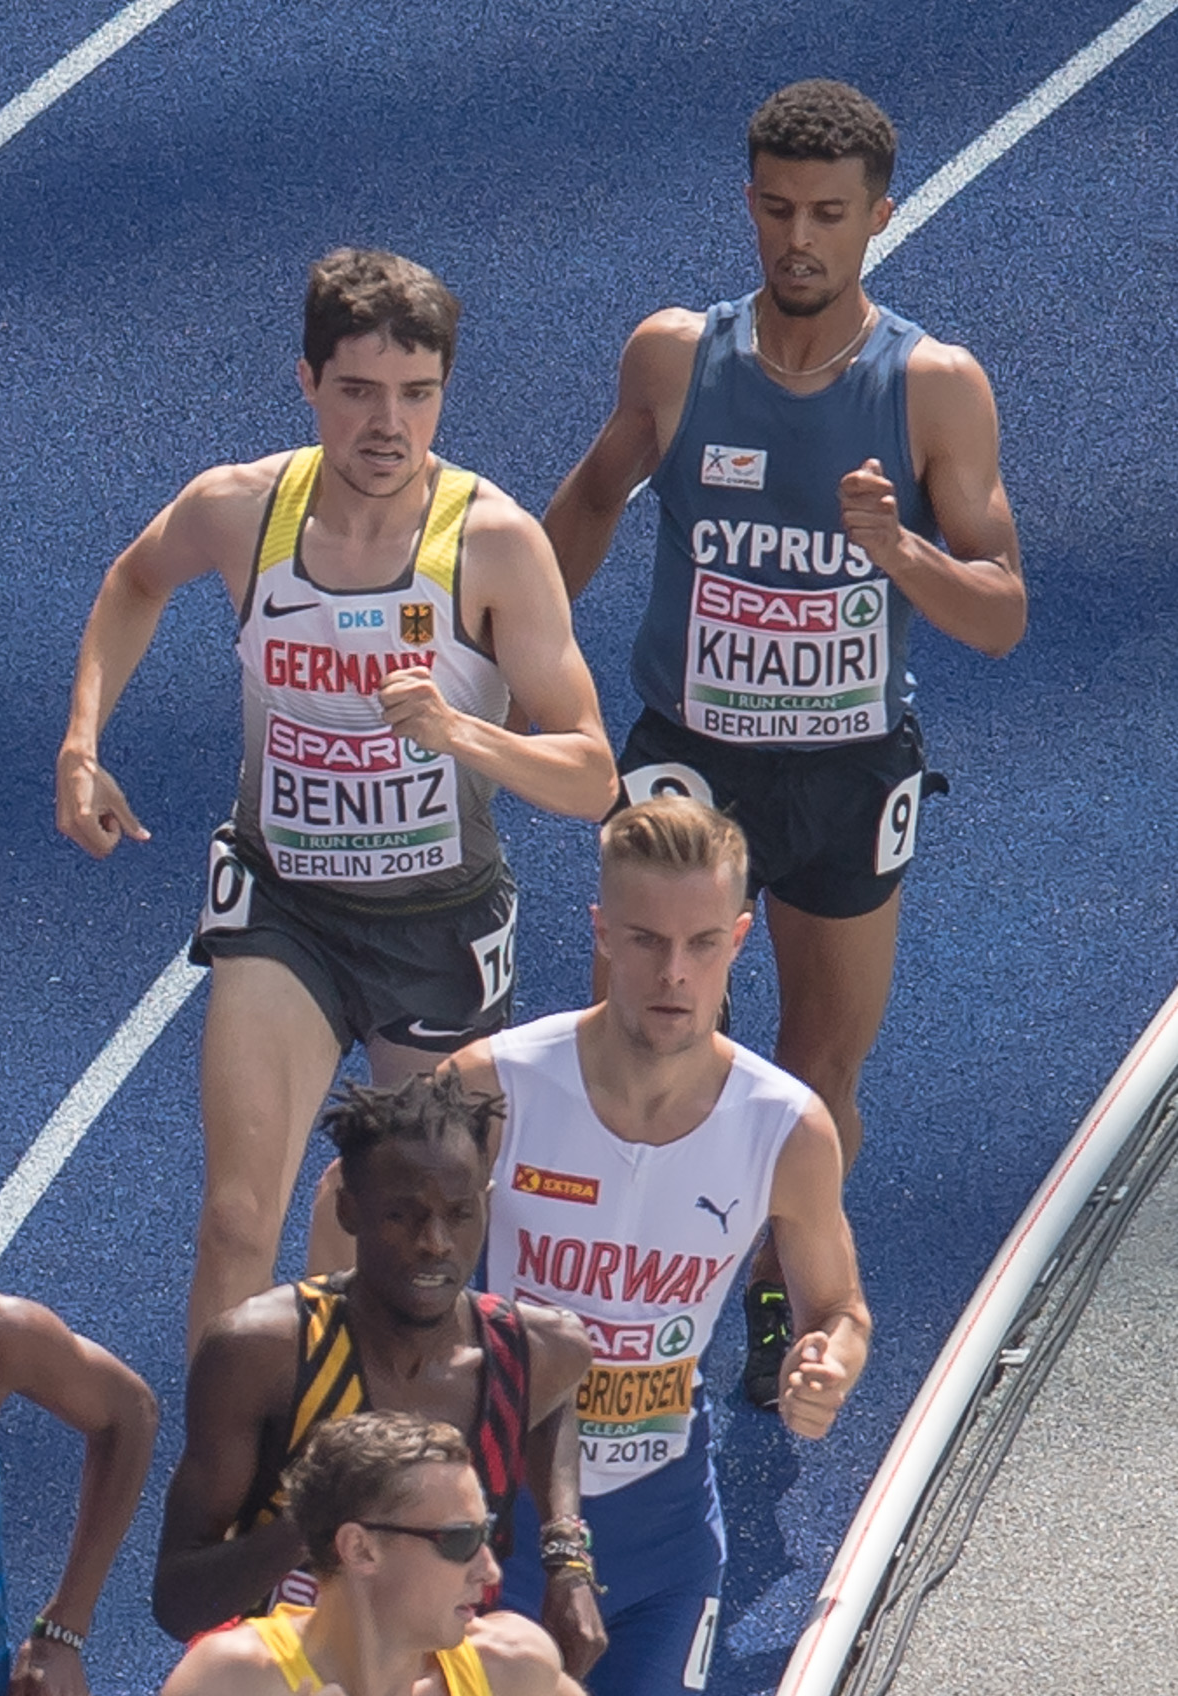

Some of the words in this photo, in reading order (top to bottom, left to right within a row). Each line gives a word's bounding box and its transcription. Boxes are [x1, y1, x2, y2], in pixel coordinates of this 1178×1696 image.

[693, 519, 873, 577] CYPRUS
[338, 609, 385, 629] DKB
[700, 582, 835, 627] SPAR
[697, 626, 877, 686] KHADIRI
[704, 708, 797, 737] BERLIN
[807, 711, 870, 736] 2018
[728, 693, 734, 706] I
[739, 695, 776, 709] RUN
[272, 721, 398, 768] SPAR
[272, 766, 447, 826] BENITZ
[300, 835, 305, 847] I
[309, 836, 348, 849] RUN
[891, 793, 912, 856] 9
[278, 850, 371, 877] BERLIN
[380, 846, 444, 875] 2018
[517, 1228, 735, 1304] NORWAY
[590, 1322, 650, 1356] AR
[576, 1362, 692, 1416] BRIGTSEN
[606, 1439, 668, 1463] 2018
